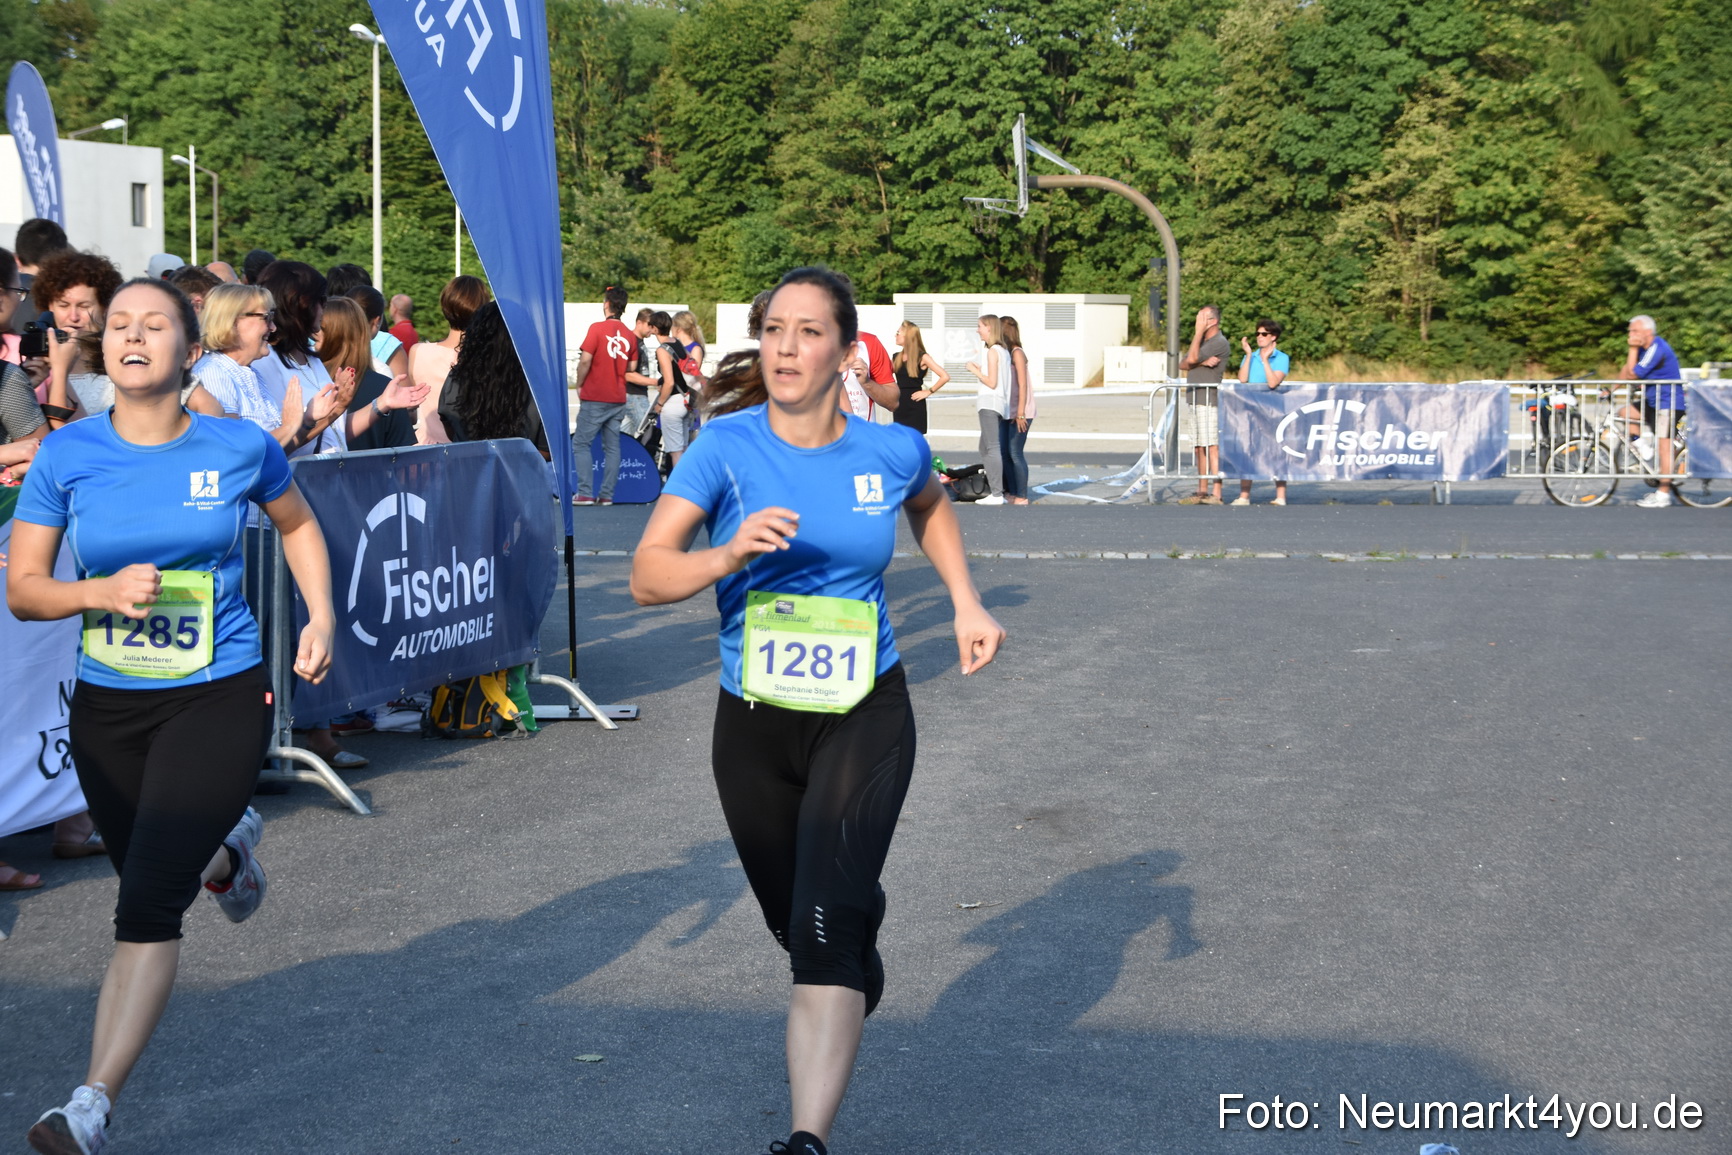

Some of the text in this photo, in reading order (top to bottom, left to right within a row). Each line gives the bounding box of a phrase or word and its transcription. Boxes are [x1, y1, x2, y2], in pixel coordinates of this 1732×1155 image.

[1306, 424, 1448, 451] Fischer
[1319, 453, 1436, 466] AUTOMOBILE
[765, 610, 812, 623] firmenlauf
[97, 613, 200, 650] 1285
[390, 612, 494, 662] AUTOMOBILE
[141, 655, 173, 663] Mederer
[758, 639, 857, 682] 1281
[774, 684, 840, 697] Stephanie Stigler
